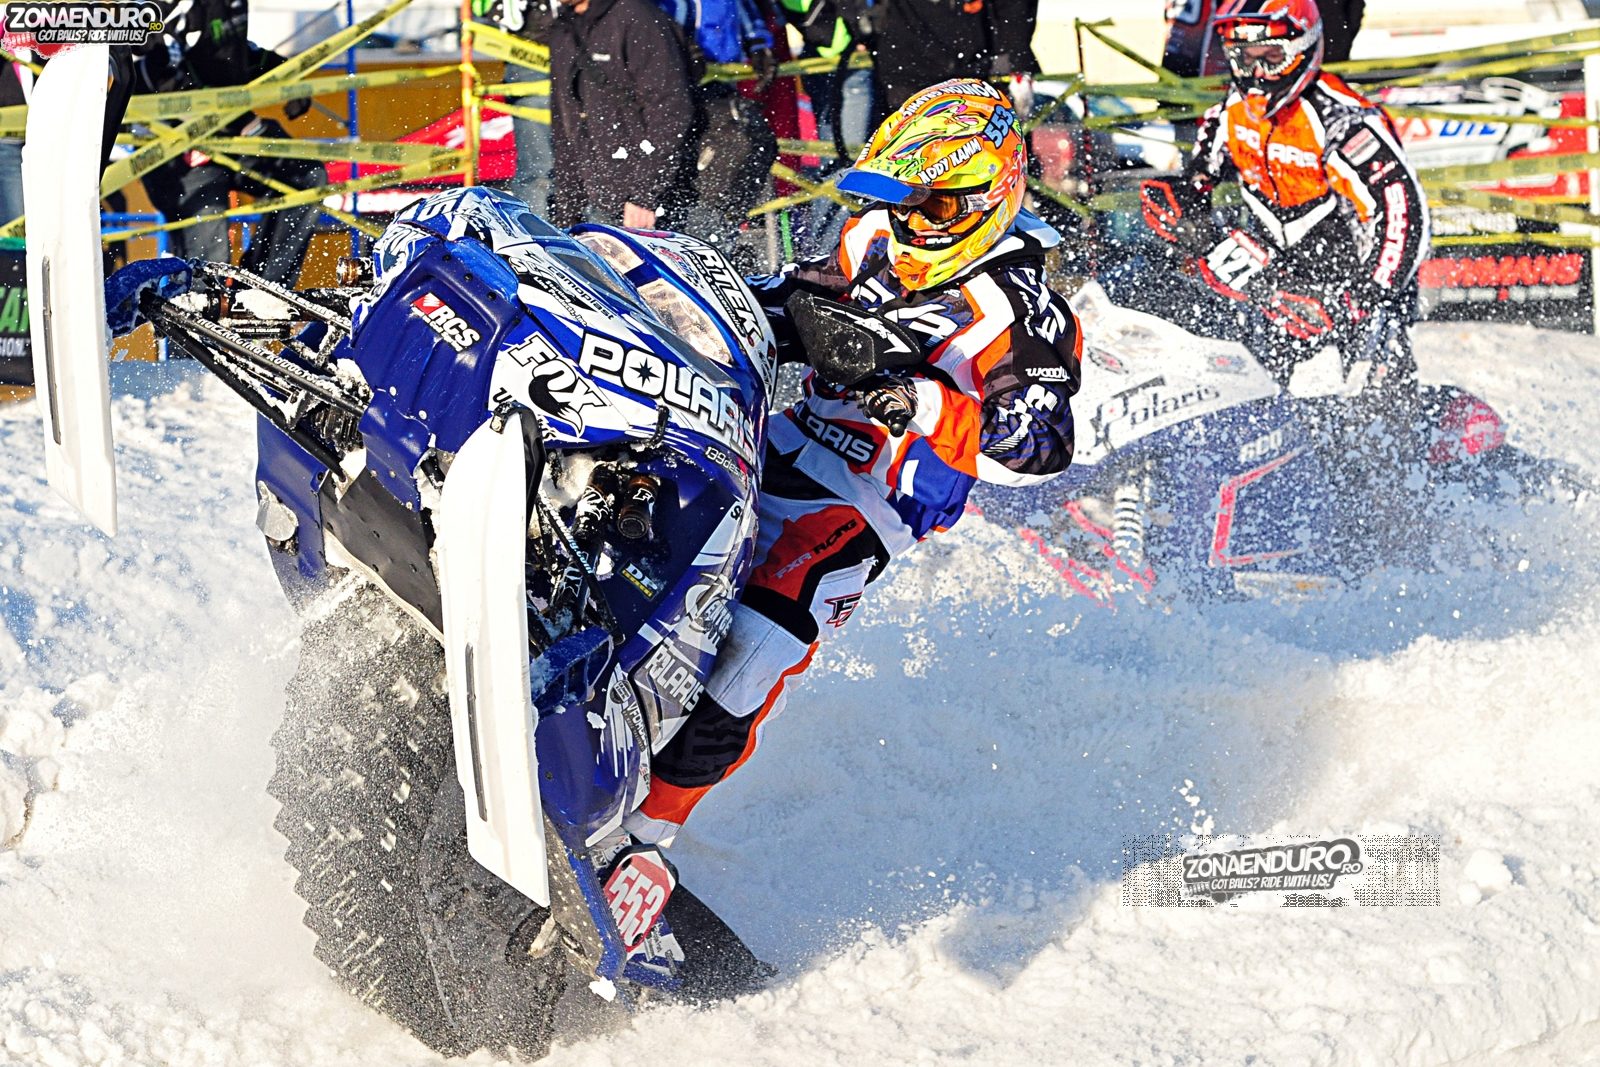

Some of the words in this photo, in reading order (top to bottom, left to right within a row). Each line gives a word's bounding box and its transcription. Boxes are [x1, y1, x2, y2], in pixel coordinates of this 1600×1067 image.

[983, 104, 1014, 149] 553
[428, 304, 481, 347] RCS
[547, 265, 615, 321] camoplast
[506, 331, 607, 414] FOX
[578, 332, 758, 466] POLARIS
[644, 644, 705, 712] POLARIS
[608, 864, 666, 947] 553
